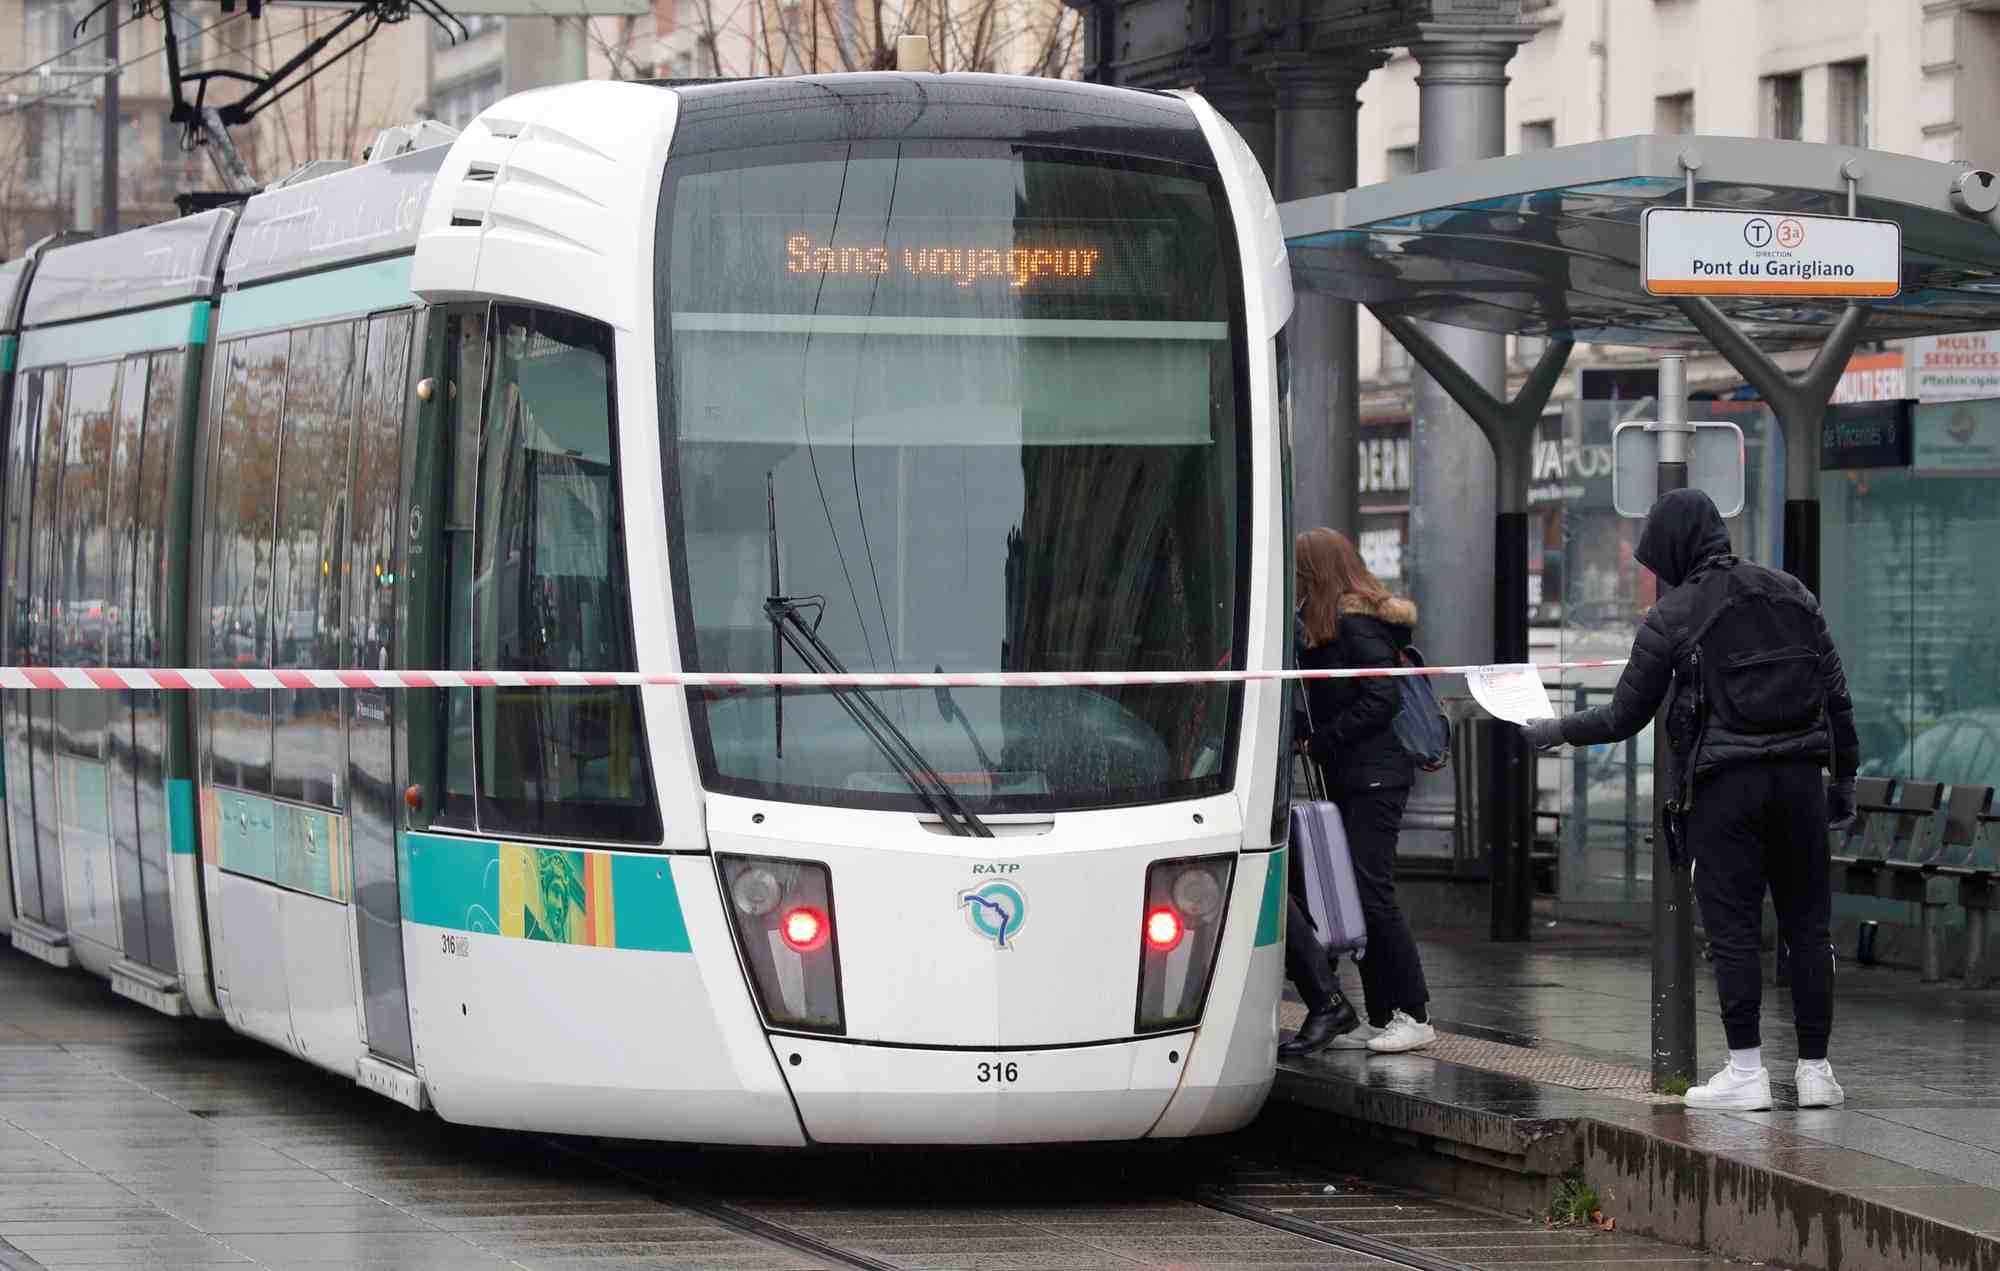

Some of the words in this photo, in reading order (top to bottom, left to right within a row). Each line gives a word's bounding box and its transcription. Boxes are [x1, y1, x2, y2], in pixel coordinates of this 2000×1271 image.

[787, 233, 889, 273] Sans
[903, 246, 1099, 288] voyageur
[1755, 250, 1792, 258] DIRECTION
[1692, 260, 1732, 275] Pont
[1738, 260, 1760, 275] du
[1766, 260, 1855, 280] Garigliano
[1936, 335, 1986, 350] MULTI
[1924, 352, 1999, 367] SERVICES
[972, 863, 1020, 874] RATP
[442, 933, 456, 954] 316
[977, 1062, 1018, 1082] 316
